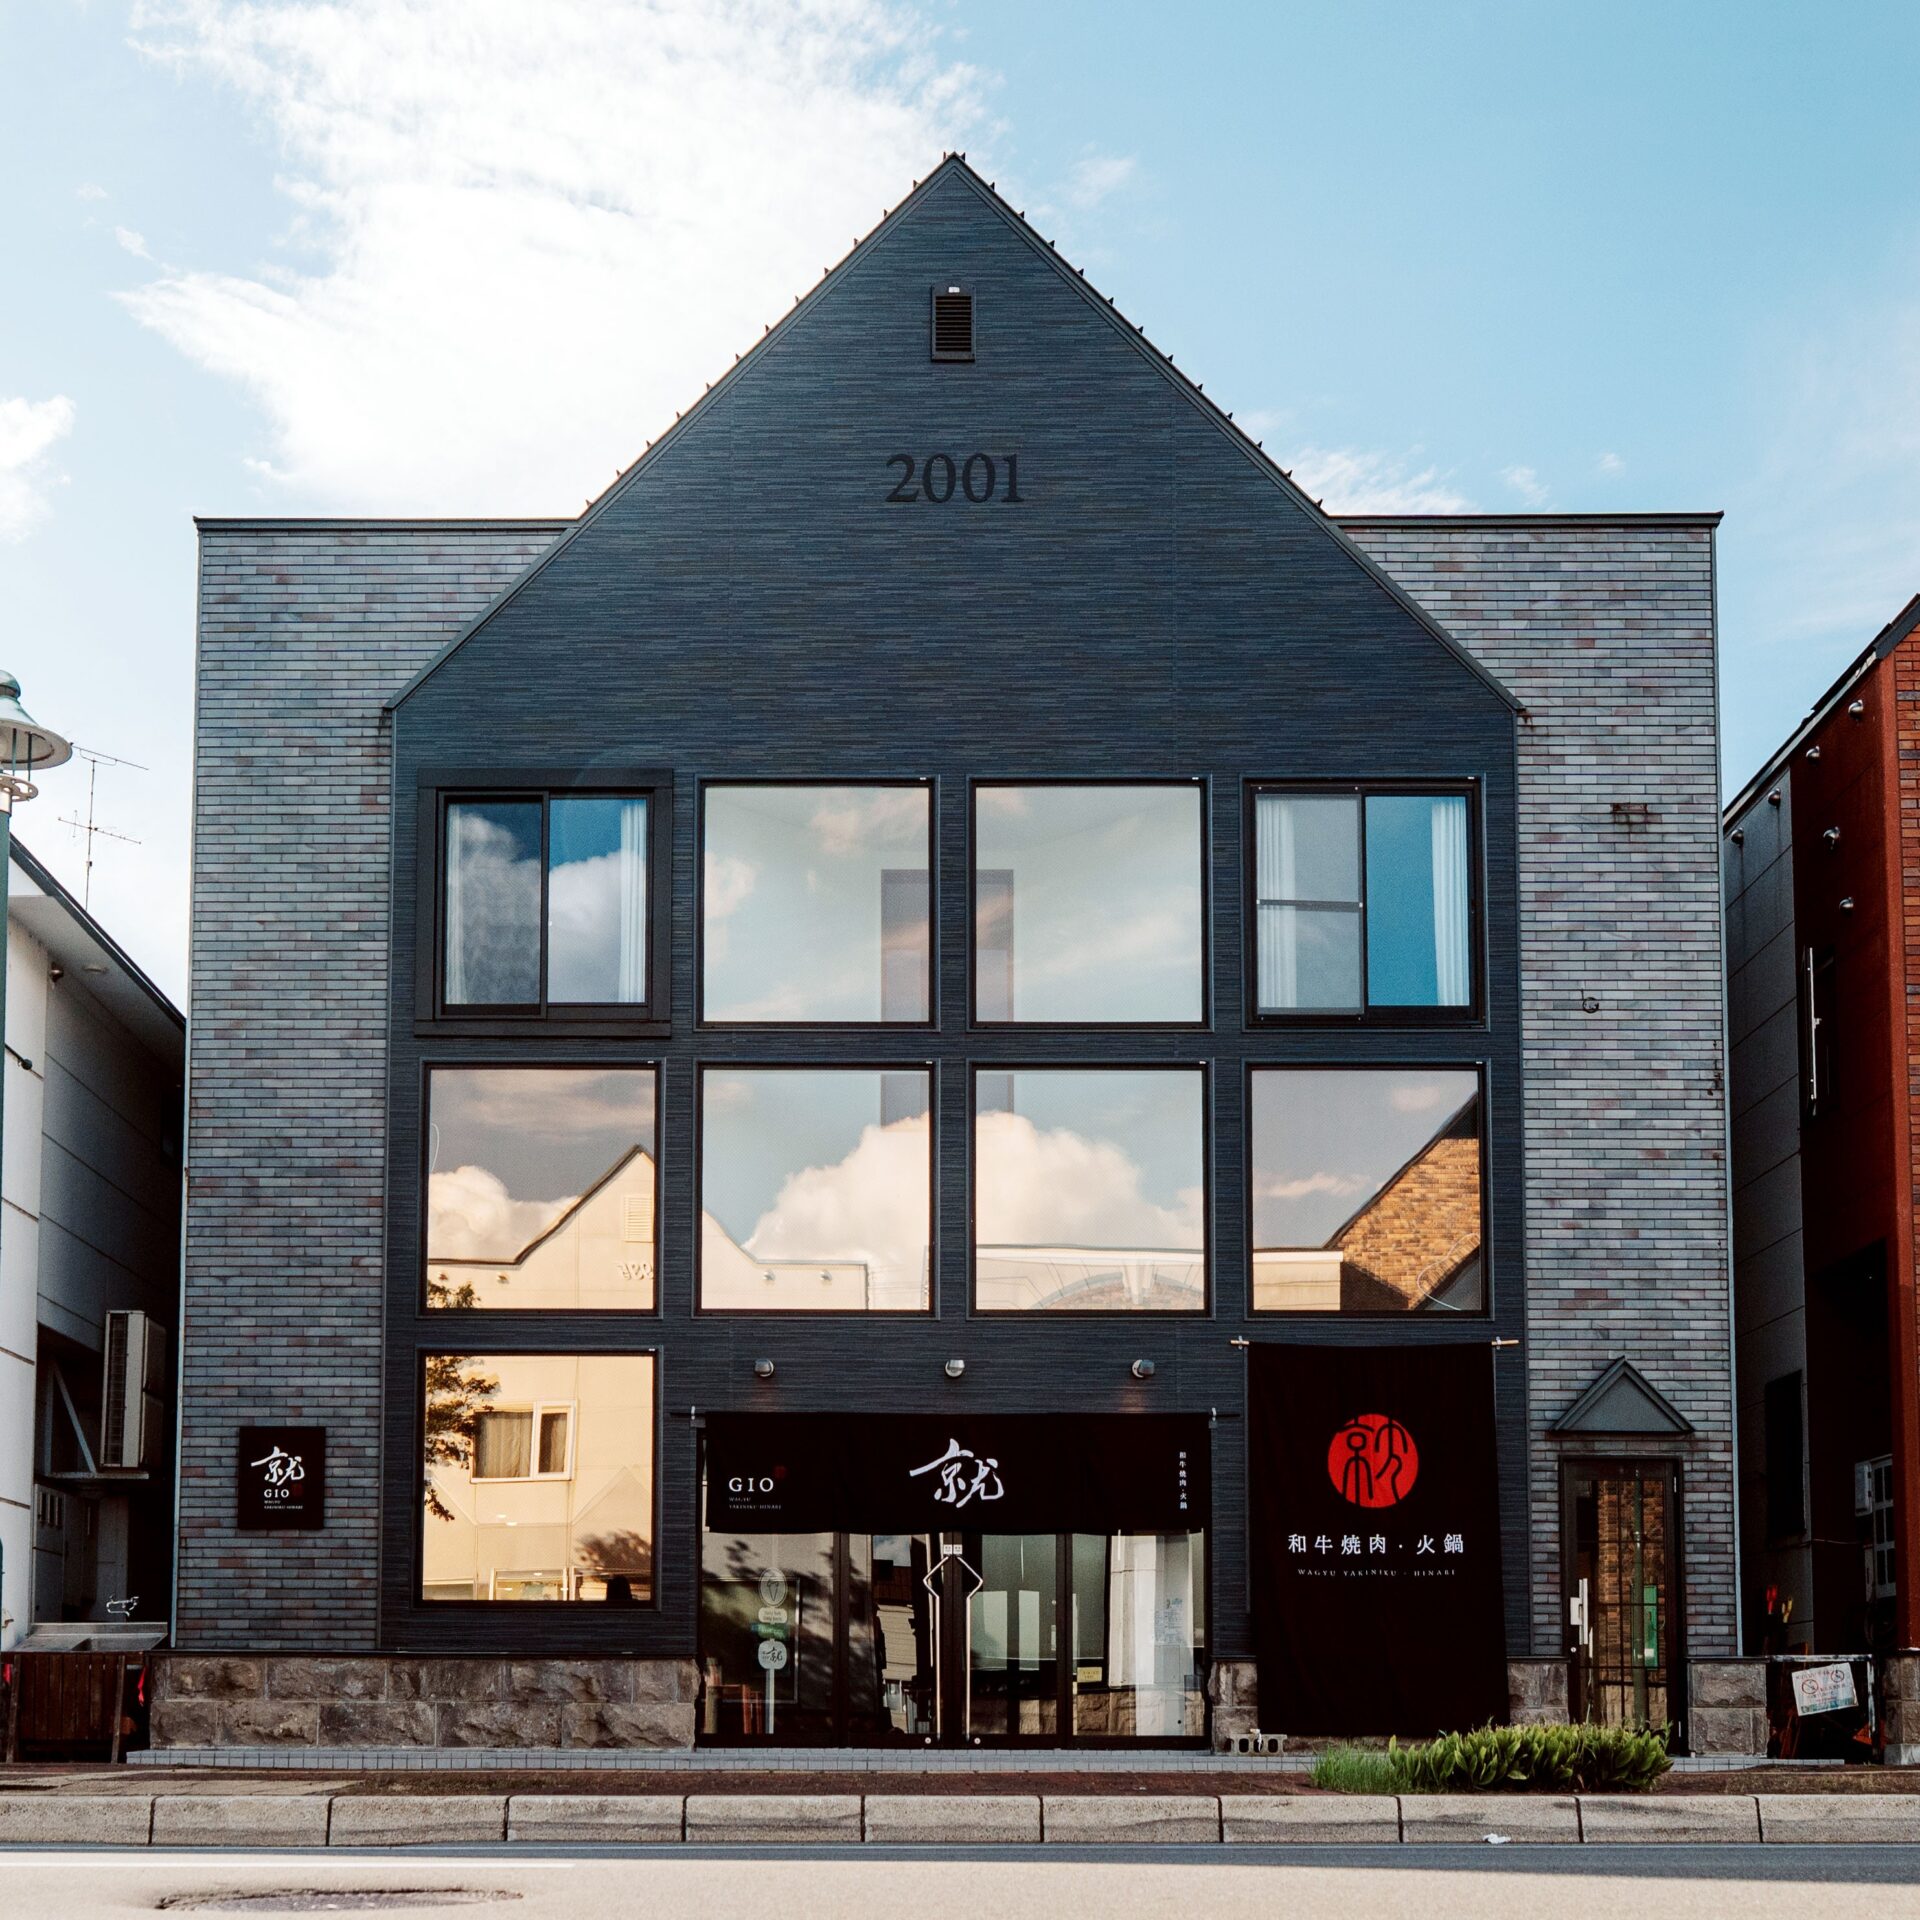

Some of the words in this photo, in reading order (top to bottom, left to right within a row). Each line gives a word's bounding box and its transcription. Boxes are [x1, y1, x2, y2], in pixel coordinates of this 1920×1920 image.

[885, 453, 1025, 504] 2001
[728, 1477, 774, 1492] GIO
[263, 1489, 290, 1498] GIO
[1297, 1568, 1336, 1576] WAGYU
[1343, 1568, 1397, 1577] YAKINIKU
